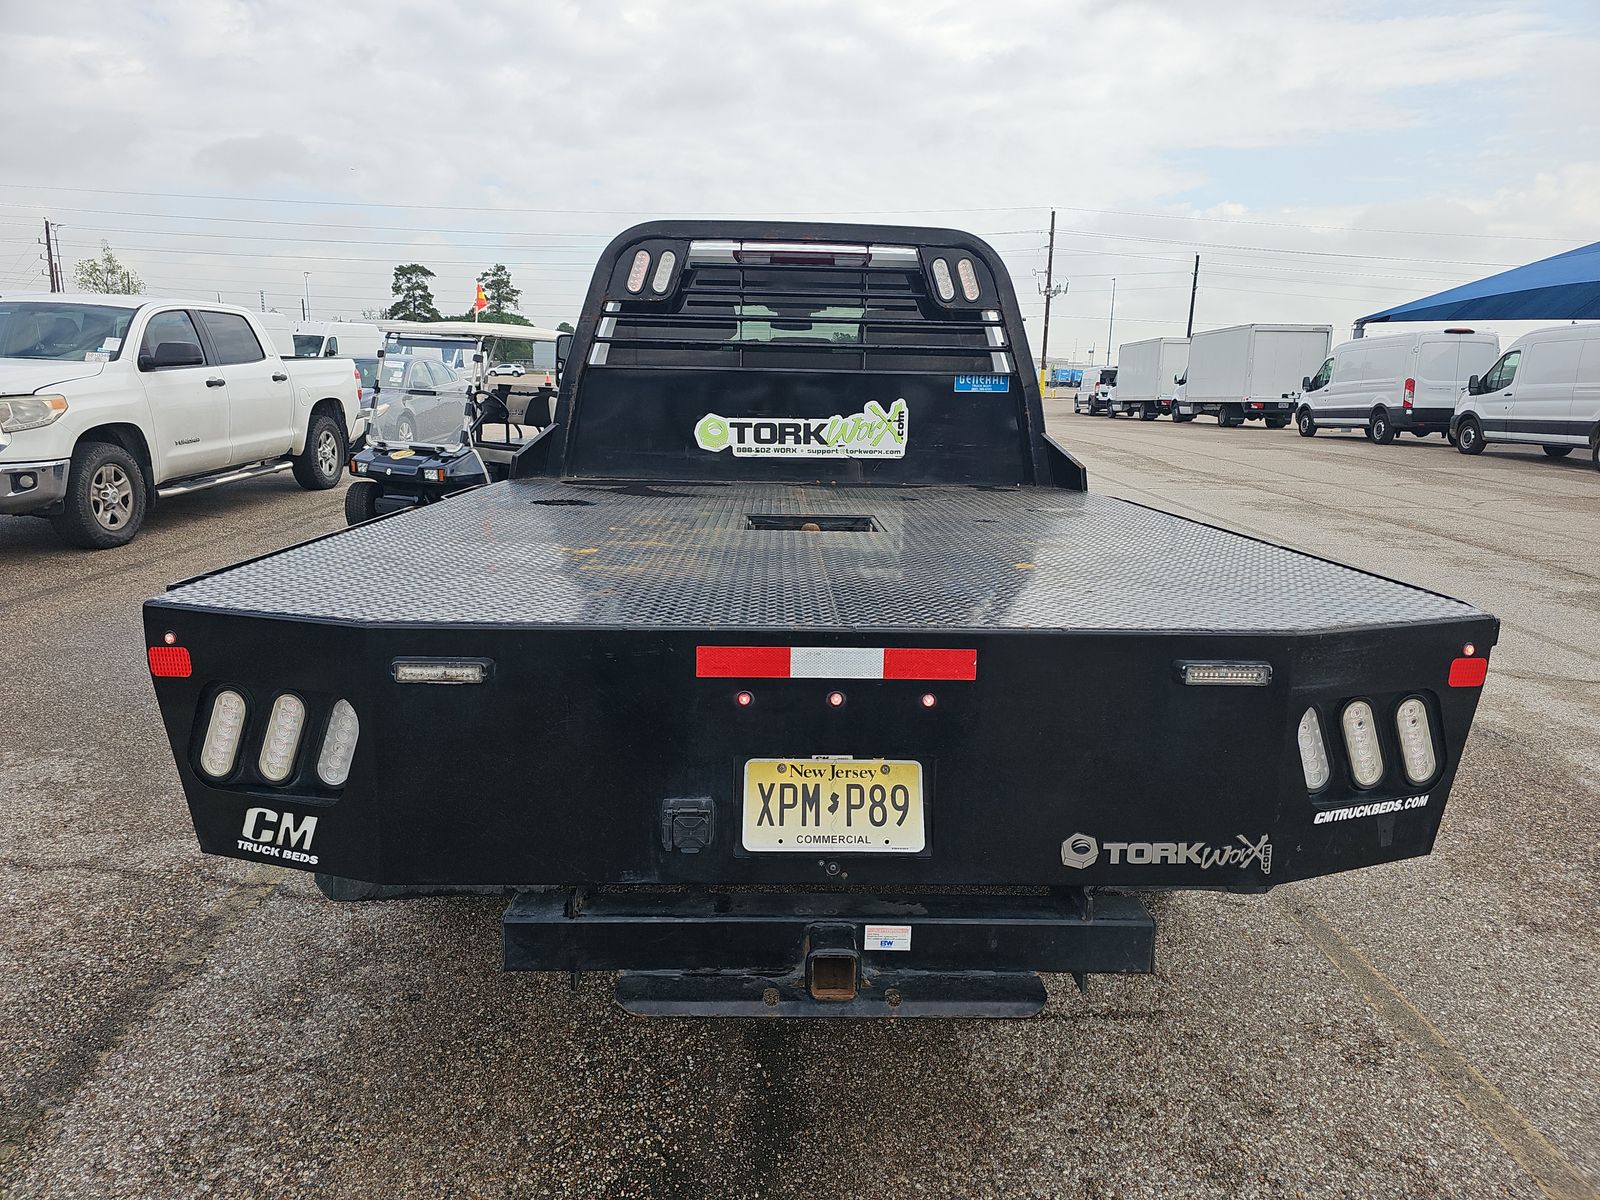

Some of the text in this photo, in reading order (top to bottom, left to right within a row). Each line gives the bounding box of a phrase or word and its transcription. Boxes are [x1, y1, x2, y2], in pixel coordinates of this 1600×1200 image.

[789, 764, 877, 782] New Jersey
[756, 783, 910, 827] XPM P89
[1313, 794, 1429, 825] CMTRUCKBEDS.COM
[242, 807, 318, 850] CM
[796, 834, 871, 845] COMMERCIAL
[237, 840, 319, 865] TRUCK BEDS
